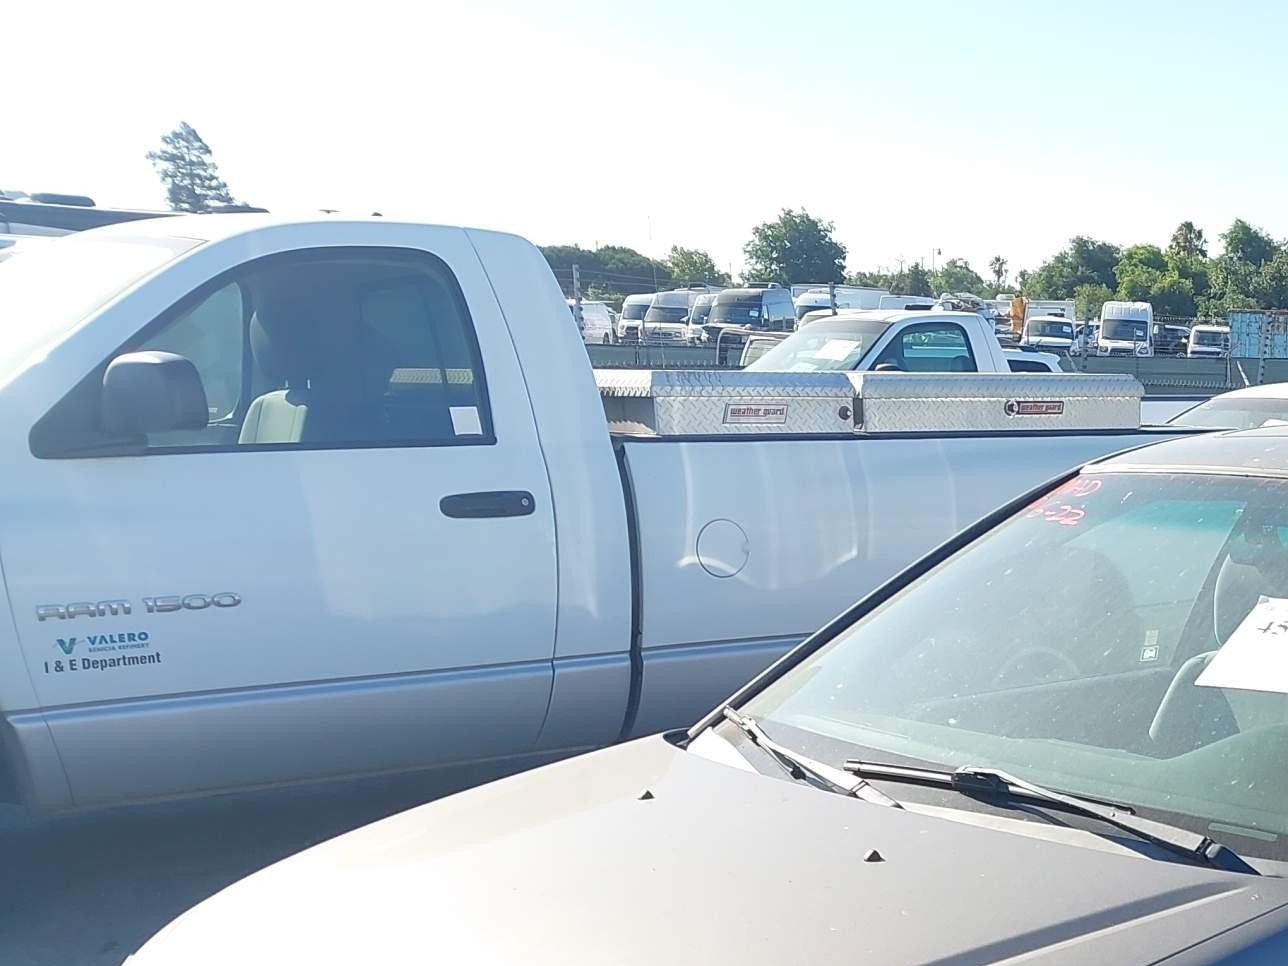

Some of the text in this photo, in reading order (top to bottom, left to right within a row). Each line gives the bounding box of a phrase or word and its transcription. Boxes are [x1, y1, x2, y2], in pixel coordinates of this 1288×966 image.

[730, 406, 784, 415] weather guard
[36, 592, 241, 621] RAM 1500
[87, 632, 149, 646] VALERO
[54, 661, 64, 673] &
[69, 659, 77, 671] E
[82, 652, 161, 671] Department
